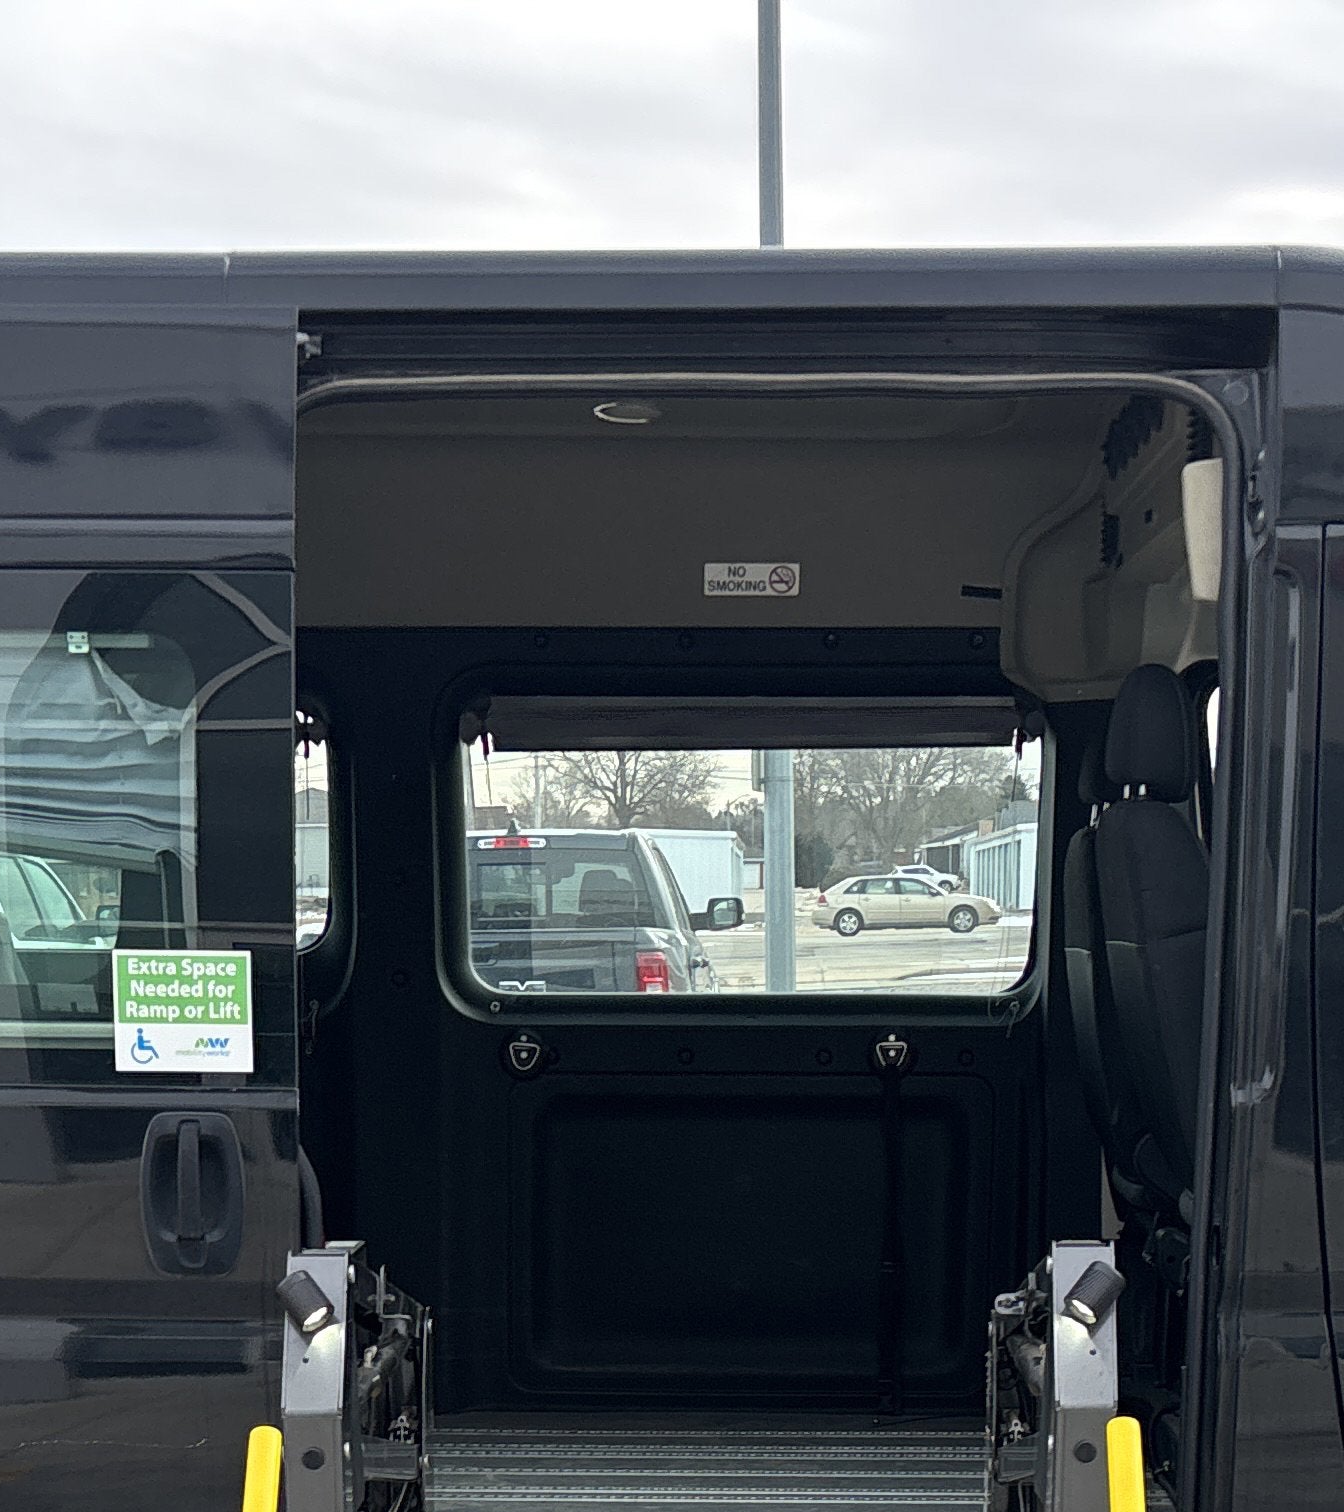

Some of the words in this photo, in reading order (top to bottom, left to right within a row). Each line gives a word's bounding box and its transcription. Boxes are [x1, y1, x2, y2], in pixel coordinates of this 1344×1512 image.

[727, 565, 747, 578] NO
[707, 579, 767, 592] SMOKING
[127, 957, 177, 976] Extra
[181, 958, 237, 980] Space
[130, 980, 204, 997] Needed
[207, 980, 236, 998] for
[125, 1000, 181, 1022] Ramp
[184, 1005, 205, 1019] or
[209, 1002, 241, 1020] Lift
